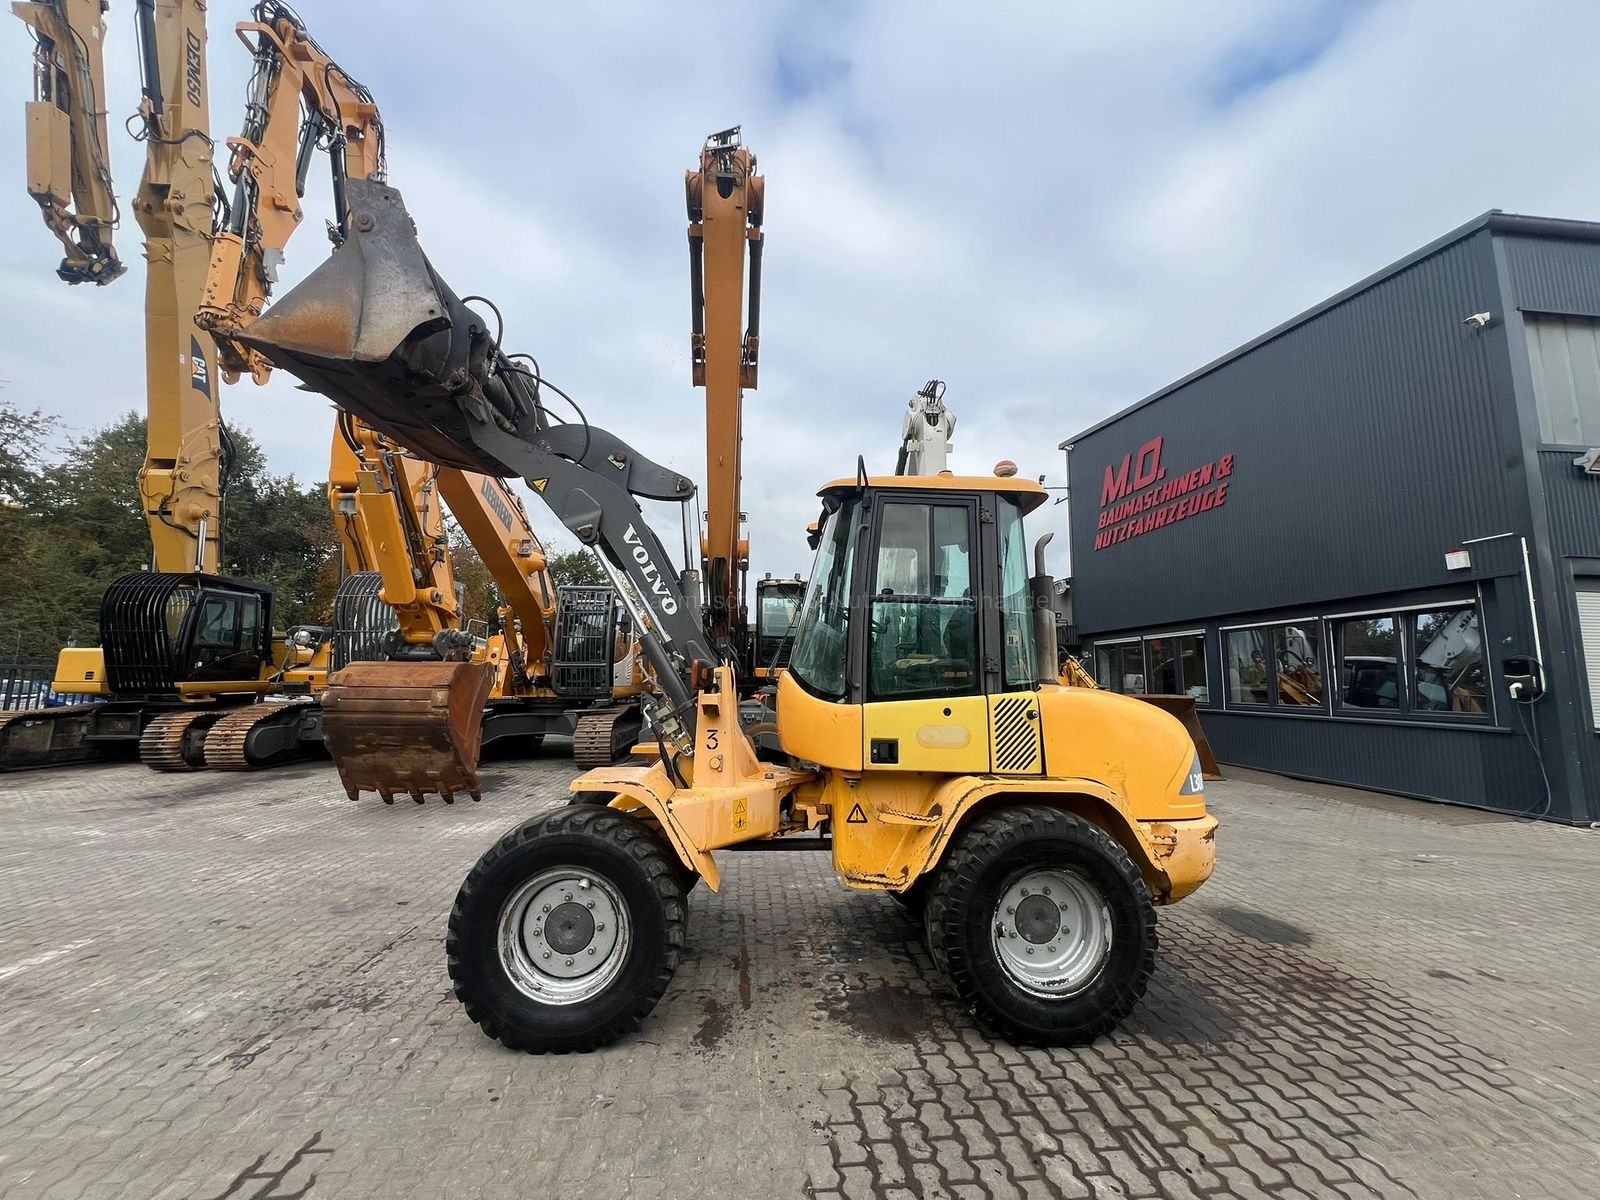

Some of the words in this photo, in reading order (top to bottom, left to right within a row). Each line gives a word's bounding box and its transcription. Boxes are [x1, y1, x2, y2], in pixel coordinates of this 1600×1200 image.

[186, 26, 201, 109] DEM50
[191, 356, 207, 384] CAT
[1094, 482, 1229, 552] NUTZFAHRZEUGE
[1098, 462, 1214, 530] BAUMASCHINEN
[1215, 453, 1234, 480] &
[623, 523, 678, 615] VOLVO
[706, 729, 719, 750] 3
